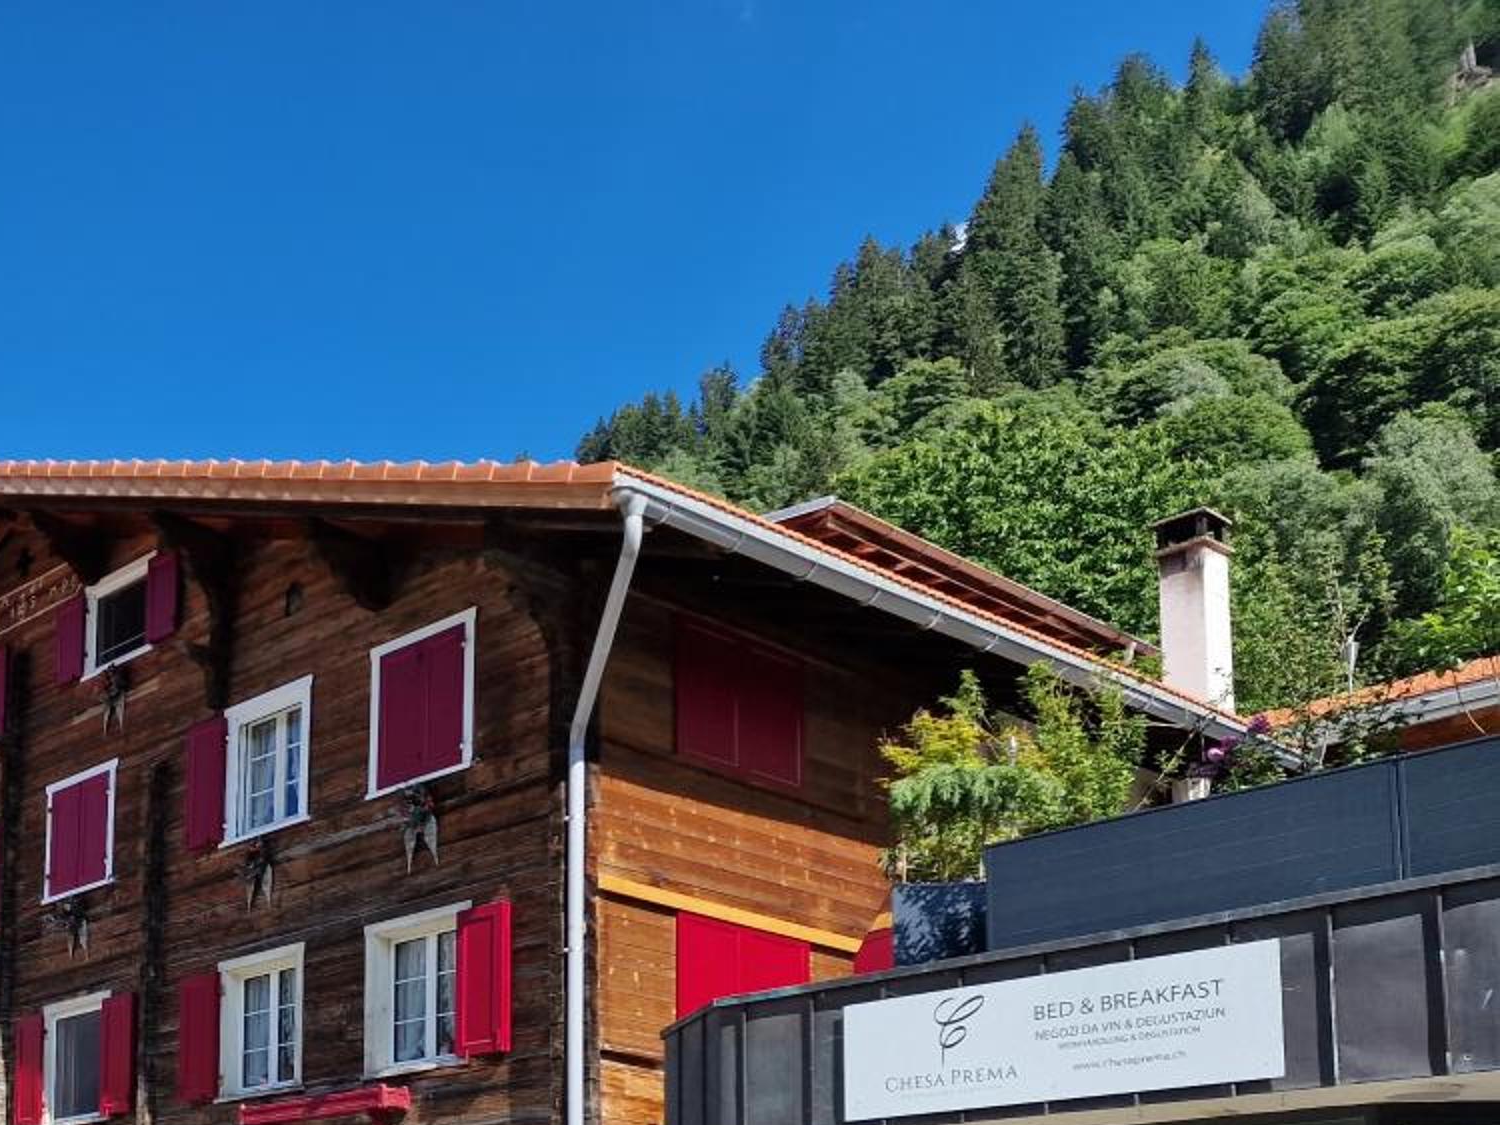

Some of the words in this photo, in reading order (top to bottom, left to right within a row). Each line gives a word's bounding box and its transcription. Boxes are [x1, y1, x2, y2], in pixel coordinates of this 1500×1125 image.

[1033, 1001, 1075, 1021] BED
[1080, 998, 1095, 1015] &
[1101, 978, 1224, 1013] BREAKFAST
[1035, 1026, 1078, 1040] NEGOZI
[1081, 1023, 1099, 1035] DA
[1101, 1020, 1122, 1032] VIN
[1124, 1018, 1133, 1029] &
[1136, 1007, 1226, 1029] DEGUSTAZIUN
[885, 1074, 945, 1093] CHESA
[951, 1065, 1018, 1085] PREMA
